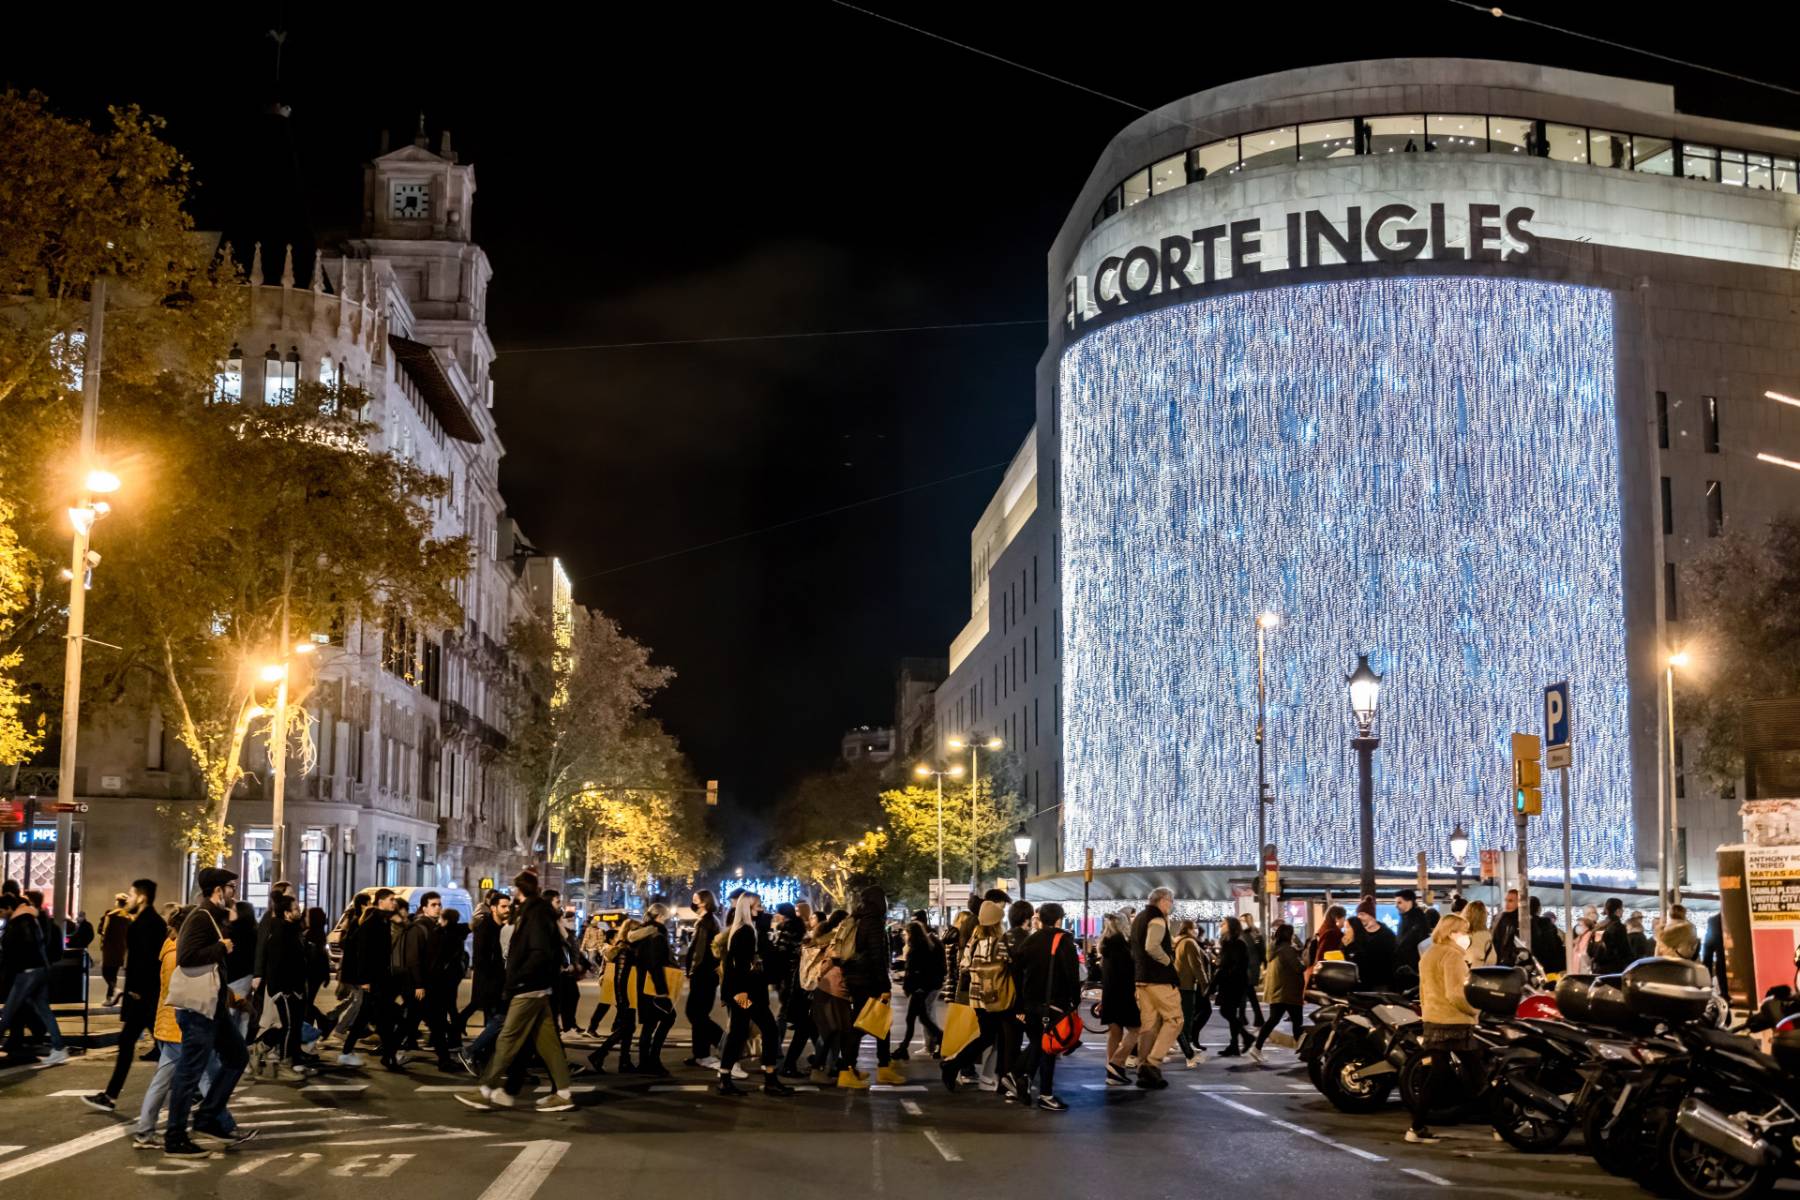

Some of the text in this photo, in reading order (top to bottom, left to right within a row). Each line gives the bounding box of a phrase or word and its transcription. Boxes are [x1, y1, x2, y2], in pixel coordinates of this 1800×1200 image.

[1094, 218, 1261, 305] CORTE
[1287, 203, 1535, 269] INGLES
[1548, 690, 1563, 741] P
[18, 828, 58, 844] CMPE
